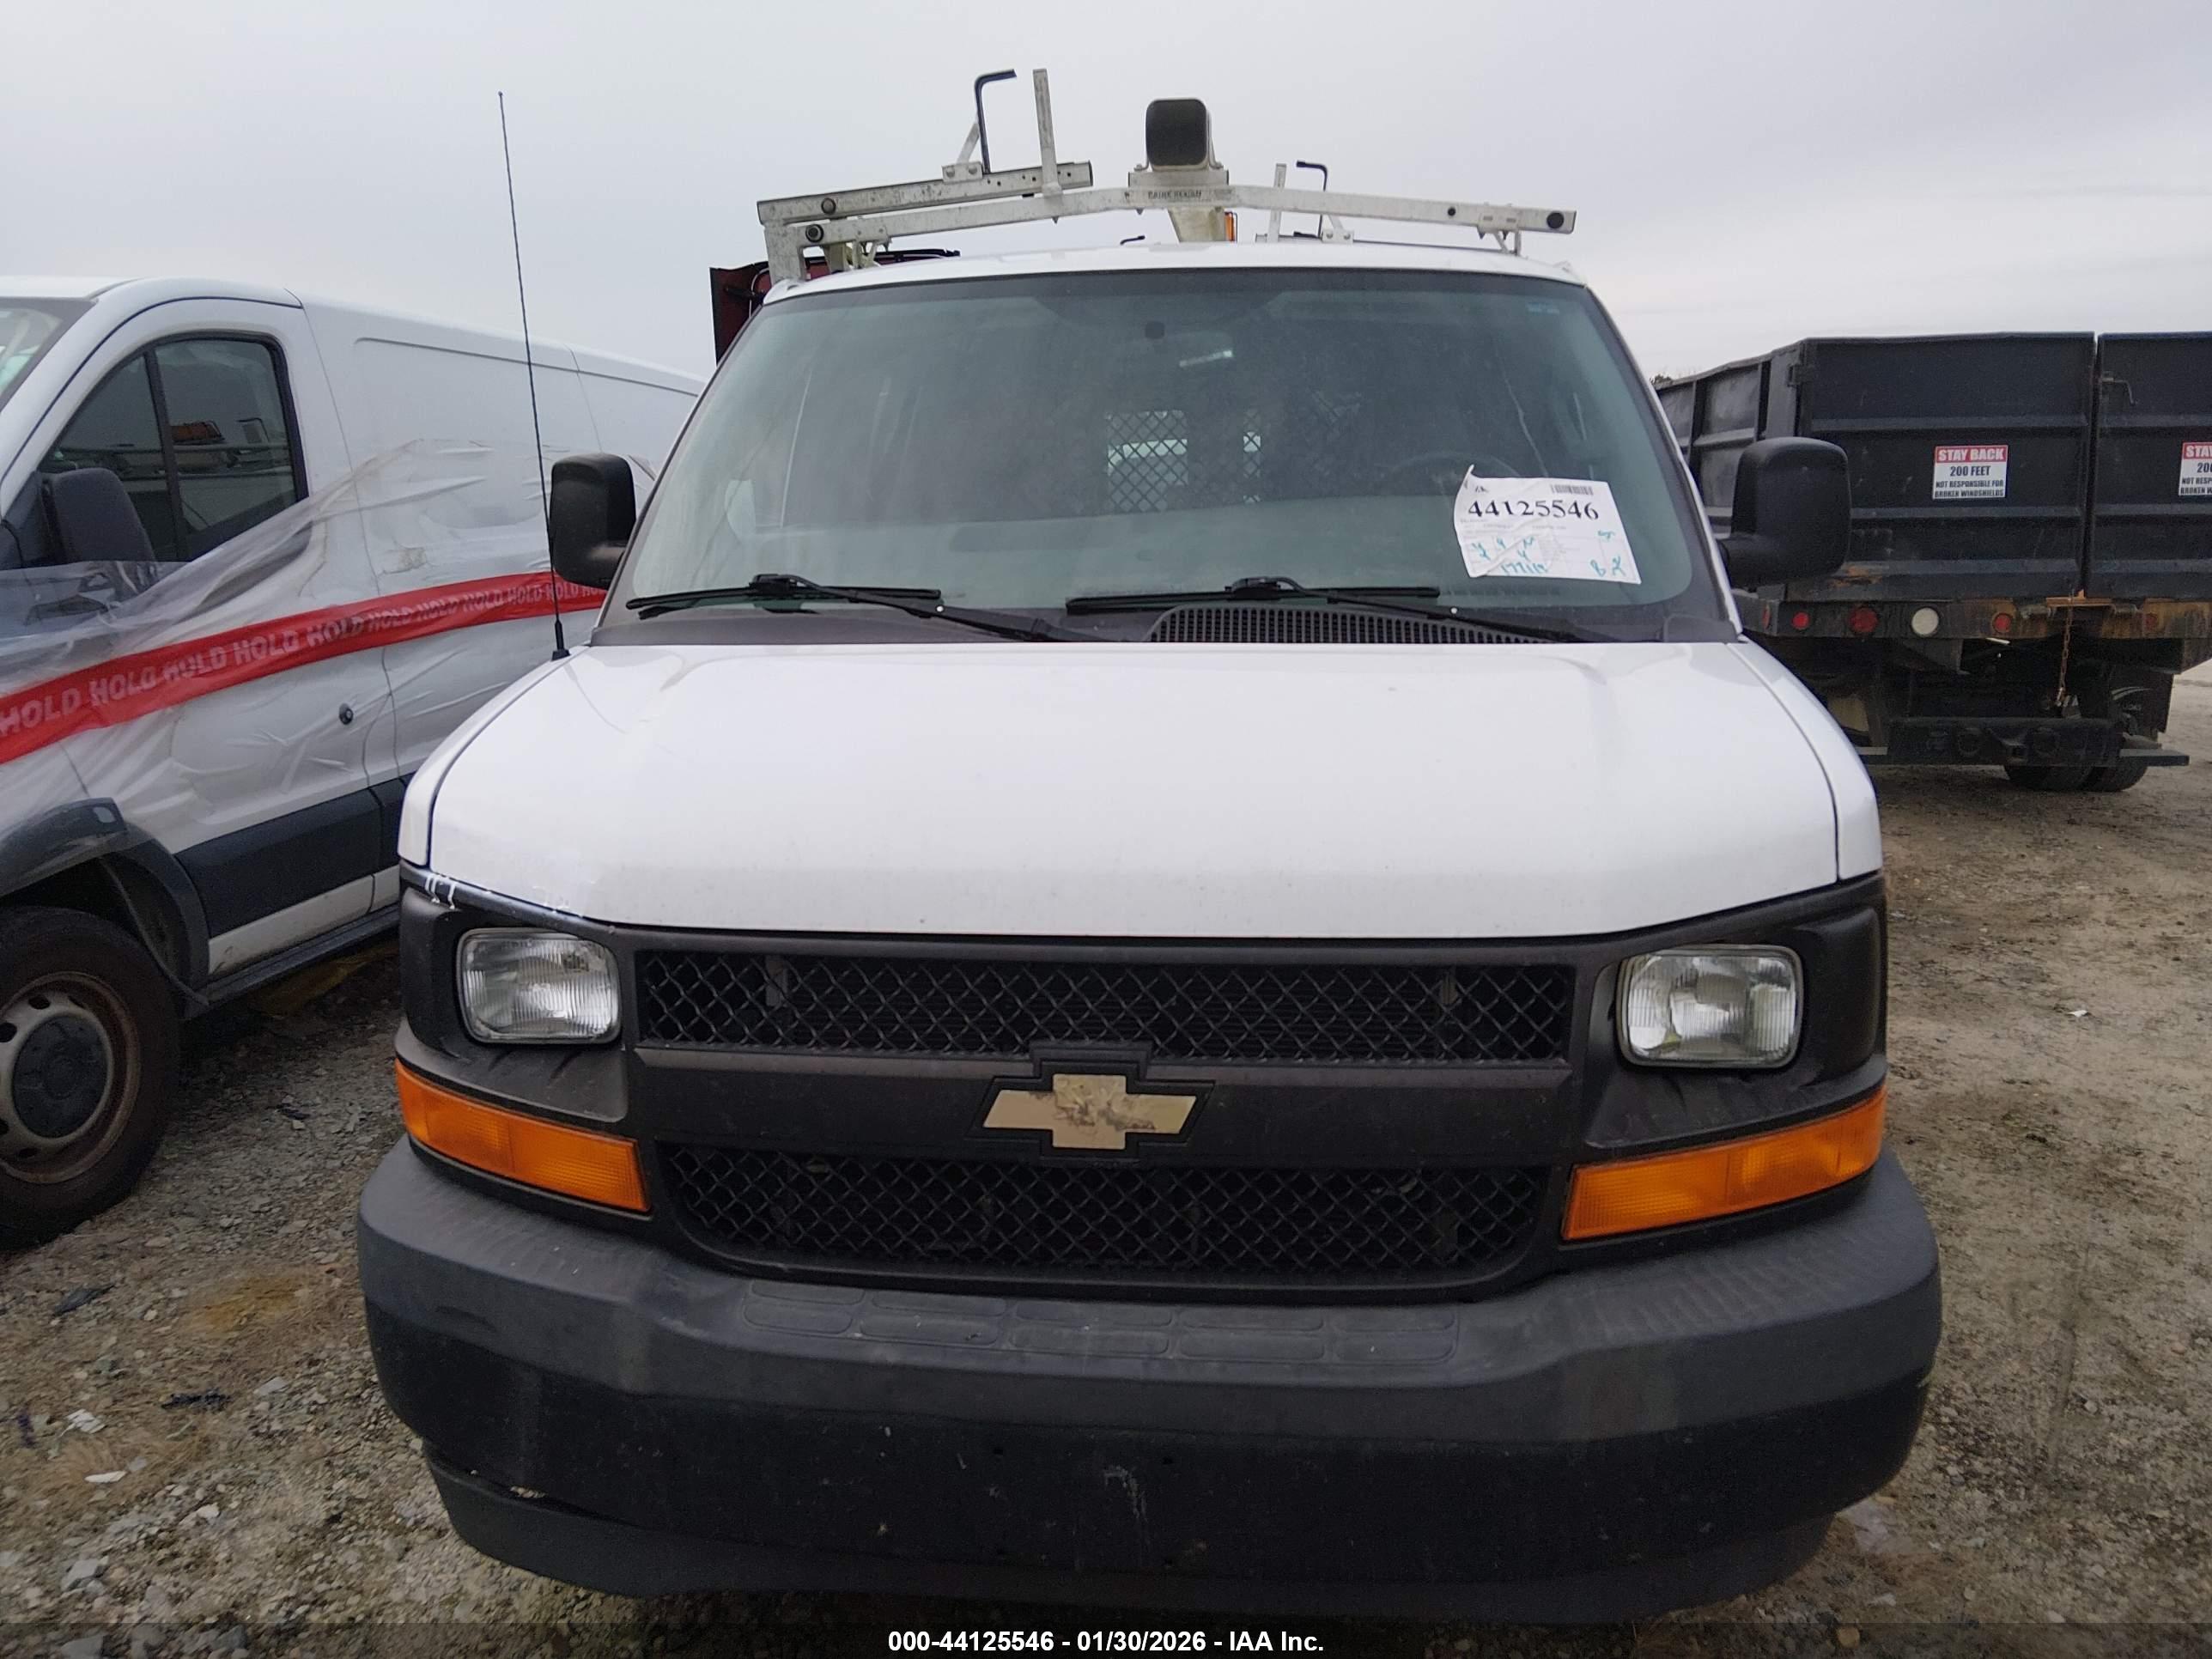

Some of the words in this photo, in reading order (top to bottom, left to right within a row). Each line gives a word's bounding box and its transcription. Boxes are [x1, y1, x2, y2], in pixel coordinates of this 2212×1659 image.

[1938, 448, 1969, 461] STAY
[1970, 448, 2004, 460] BACK
[2185, 445, 2212, 458] STA
[1950, 465, 1969, 477] 200
[1971, 465, 1991, 476] FEET
[1936, 480, 1948, 489] NOT
[1949, 479, 1990, 489] RESPONSIBLE
[1935, 489, 1960, 498] BROKEN
[1960, 489, 2004, 497] WINDSHIELDS
[1468, 499, 1599, 520] 44125546
[0, 688, 81, 736] HOLD
[88, 666, 156, 707] HOLD
[161, 646, 227, 681] HOLD
[233, 629, 299, 665] HOLD
[307, 615, 364, 647] HOLD
[368, 606, 413, 633] HOLD
[416, 593, 459, 622] HOLD
[463, 588, 504, 613] HOLD
[507, 582, 543, 605] HOLD
[545, 581, 579, 601] HOLD
